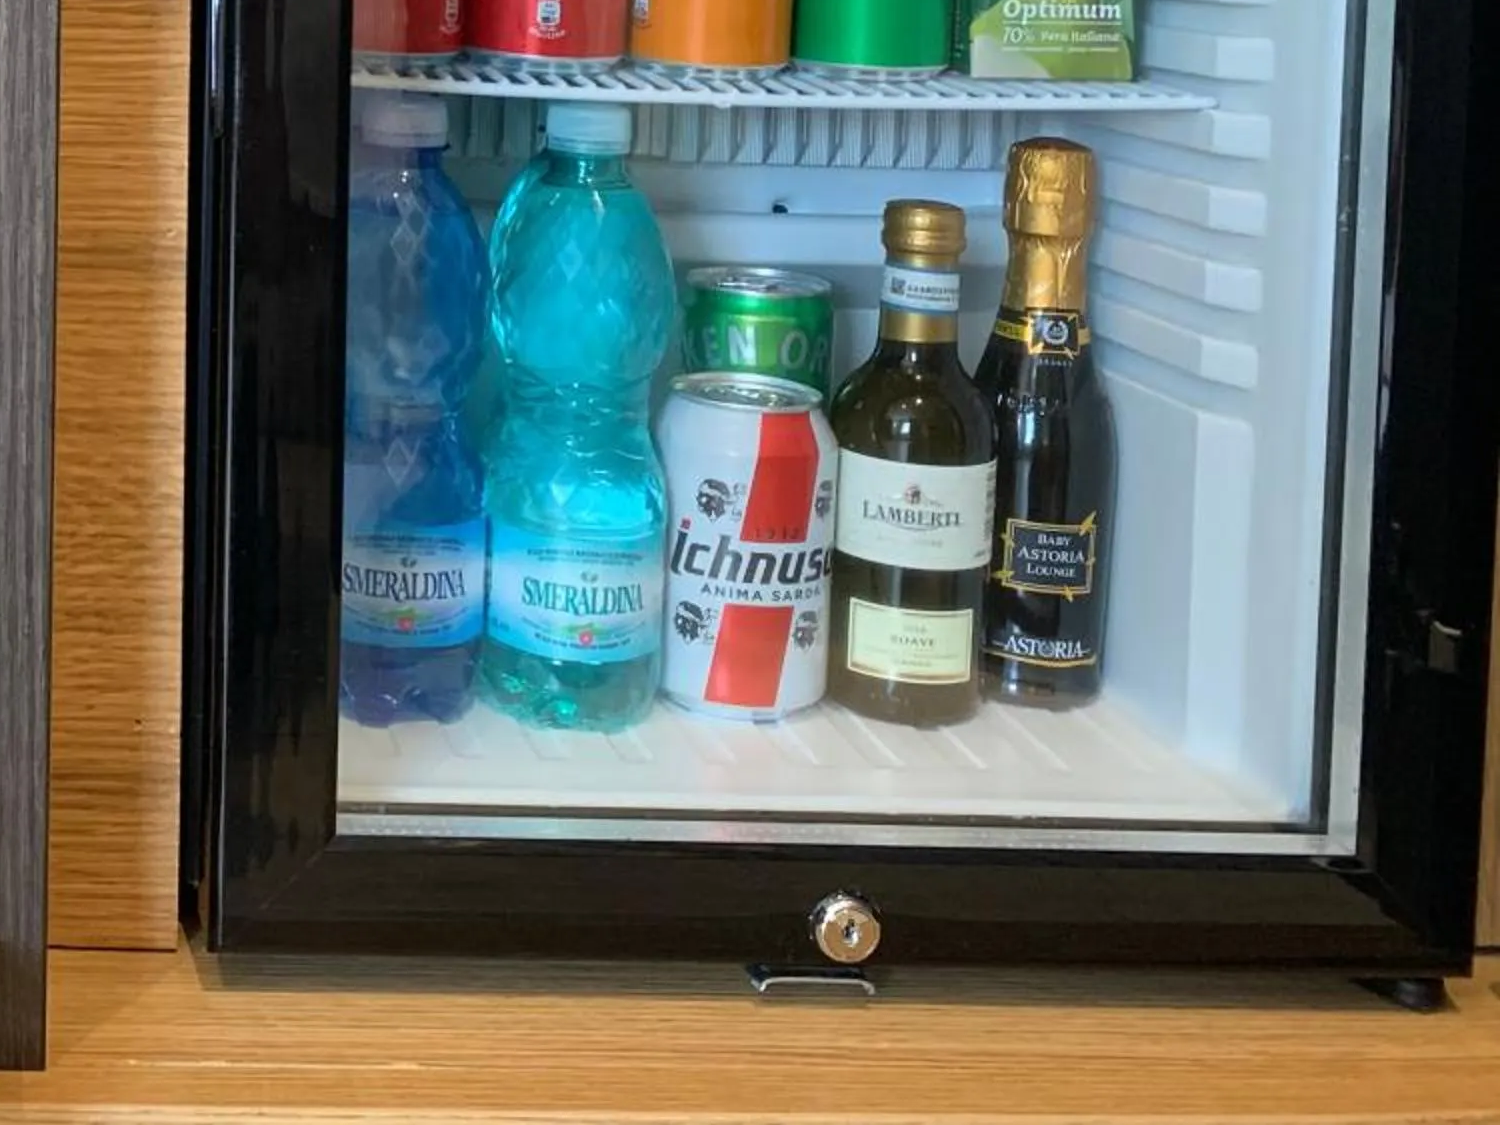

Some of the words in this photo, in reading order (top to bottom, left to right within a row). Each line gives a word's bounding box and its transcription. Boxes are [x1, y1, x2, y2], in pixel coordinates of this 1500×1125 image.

[1003, 0, 1122, 24] Optimum
[862, 499, 962, 528] LAMBERTI
[1037, 533, 1073, 546] BABY
[1017, 546, 1085, 564] ASTORIA
[1026, 562, 1077, 577] LOUNGE
[342, 562, 467, 603] SMERALDINA
[701, 583, 764, 603] ANIMA
[521, 577, 645, 616] SMERALDINA
[1004, 635, 1084, 660] ASTORIA
